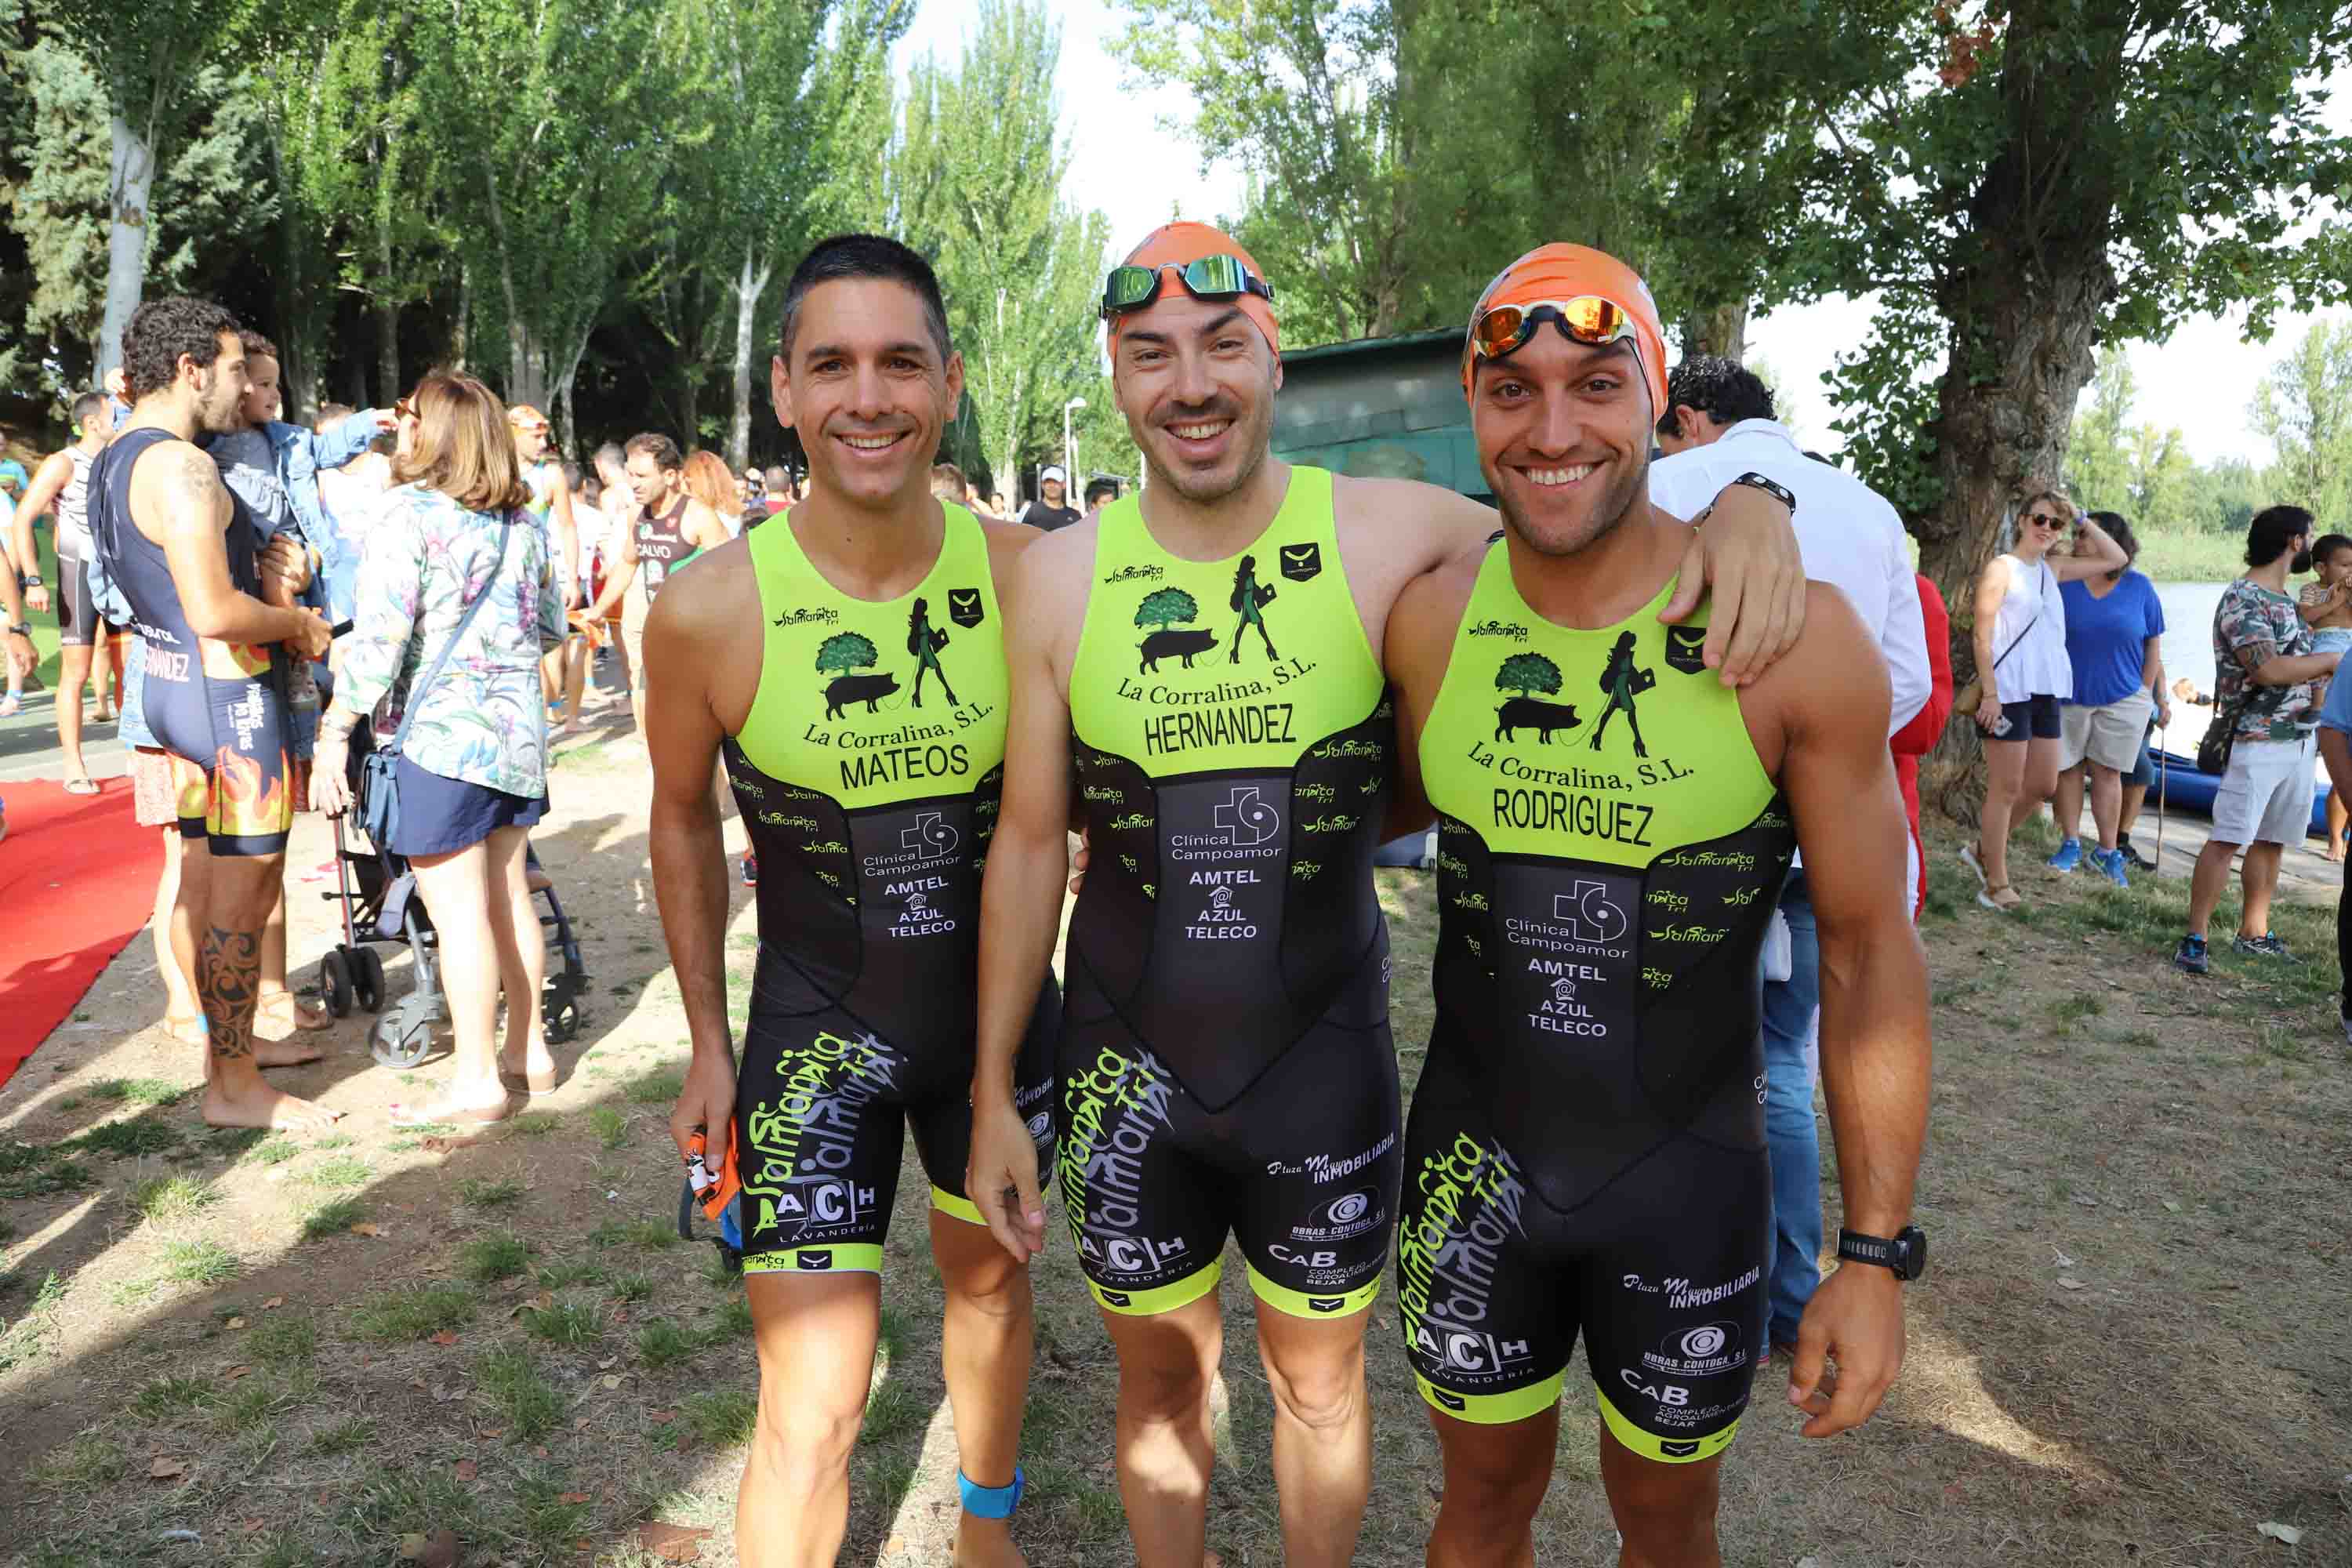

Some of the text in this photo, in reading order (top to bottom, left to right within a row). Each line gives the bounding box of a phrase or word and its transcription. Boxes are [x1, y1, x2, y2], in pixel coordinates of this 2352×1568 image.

[1116, 656, 1317, 706] La Corralina, S.L.
[803, 702, 994, 749] La Corralina, S.L.
[1144, 703, 1298, 756] HERNANDEZ
[840, 744, 970, 790] MATEOS
[1468, 741, 1695, 793] La Corralina, S.L.
[1493, 787, 1655, 848] RODRIGUEZ
[1172, 835, 1229, 847] Clínica
[863, 851, 916, 866] Clínica
[1172, 846, 1283, 862] Campoamor
[865, 856, 960, 877] Campoamor
[884, 877, 949, 896] AMTEL
[1189, 870, 1261, 886] AMTEL
[898, 908, 944, 923] AZUL
[1198, 909, 1247, 922] AZUL
[888, 920, 956, 938] TELECO
[1185, 925, 1258, 939] TELECO
[1505, 917, 1570, 937] Clínica
[1508, 932, 1631, 959] Campoamor
[1528, 958, 1606, 982] AMTEL
[1541, 1000, 1594, 1018] AZUL
[1528, 1014, 1607, 1037] TELECO
[1313, 1131, 1395, 1184] INMOBILIARIA
[1267, 1161, 1302, 1175] Plaza
[1292, 1226, 1327, 1236] OBRAS
[1624, 1274, 1659, 1293] Plaza
[1669, 1266, 1759, 1308] INMOBILIARIA
[1643, 1352, 1679, 1368] OBRAS
